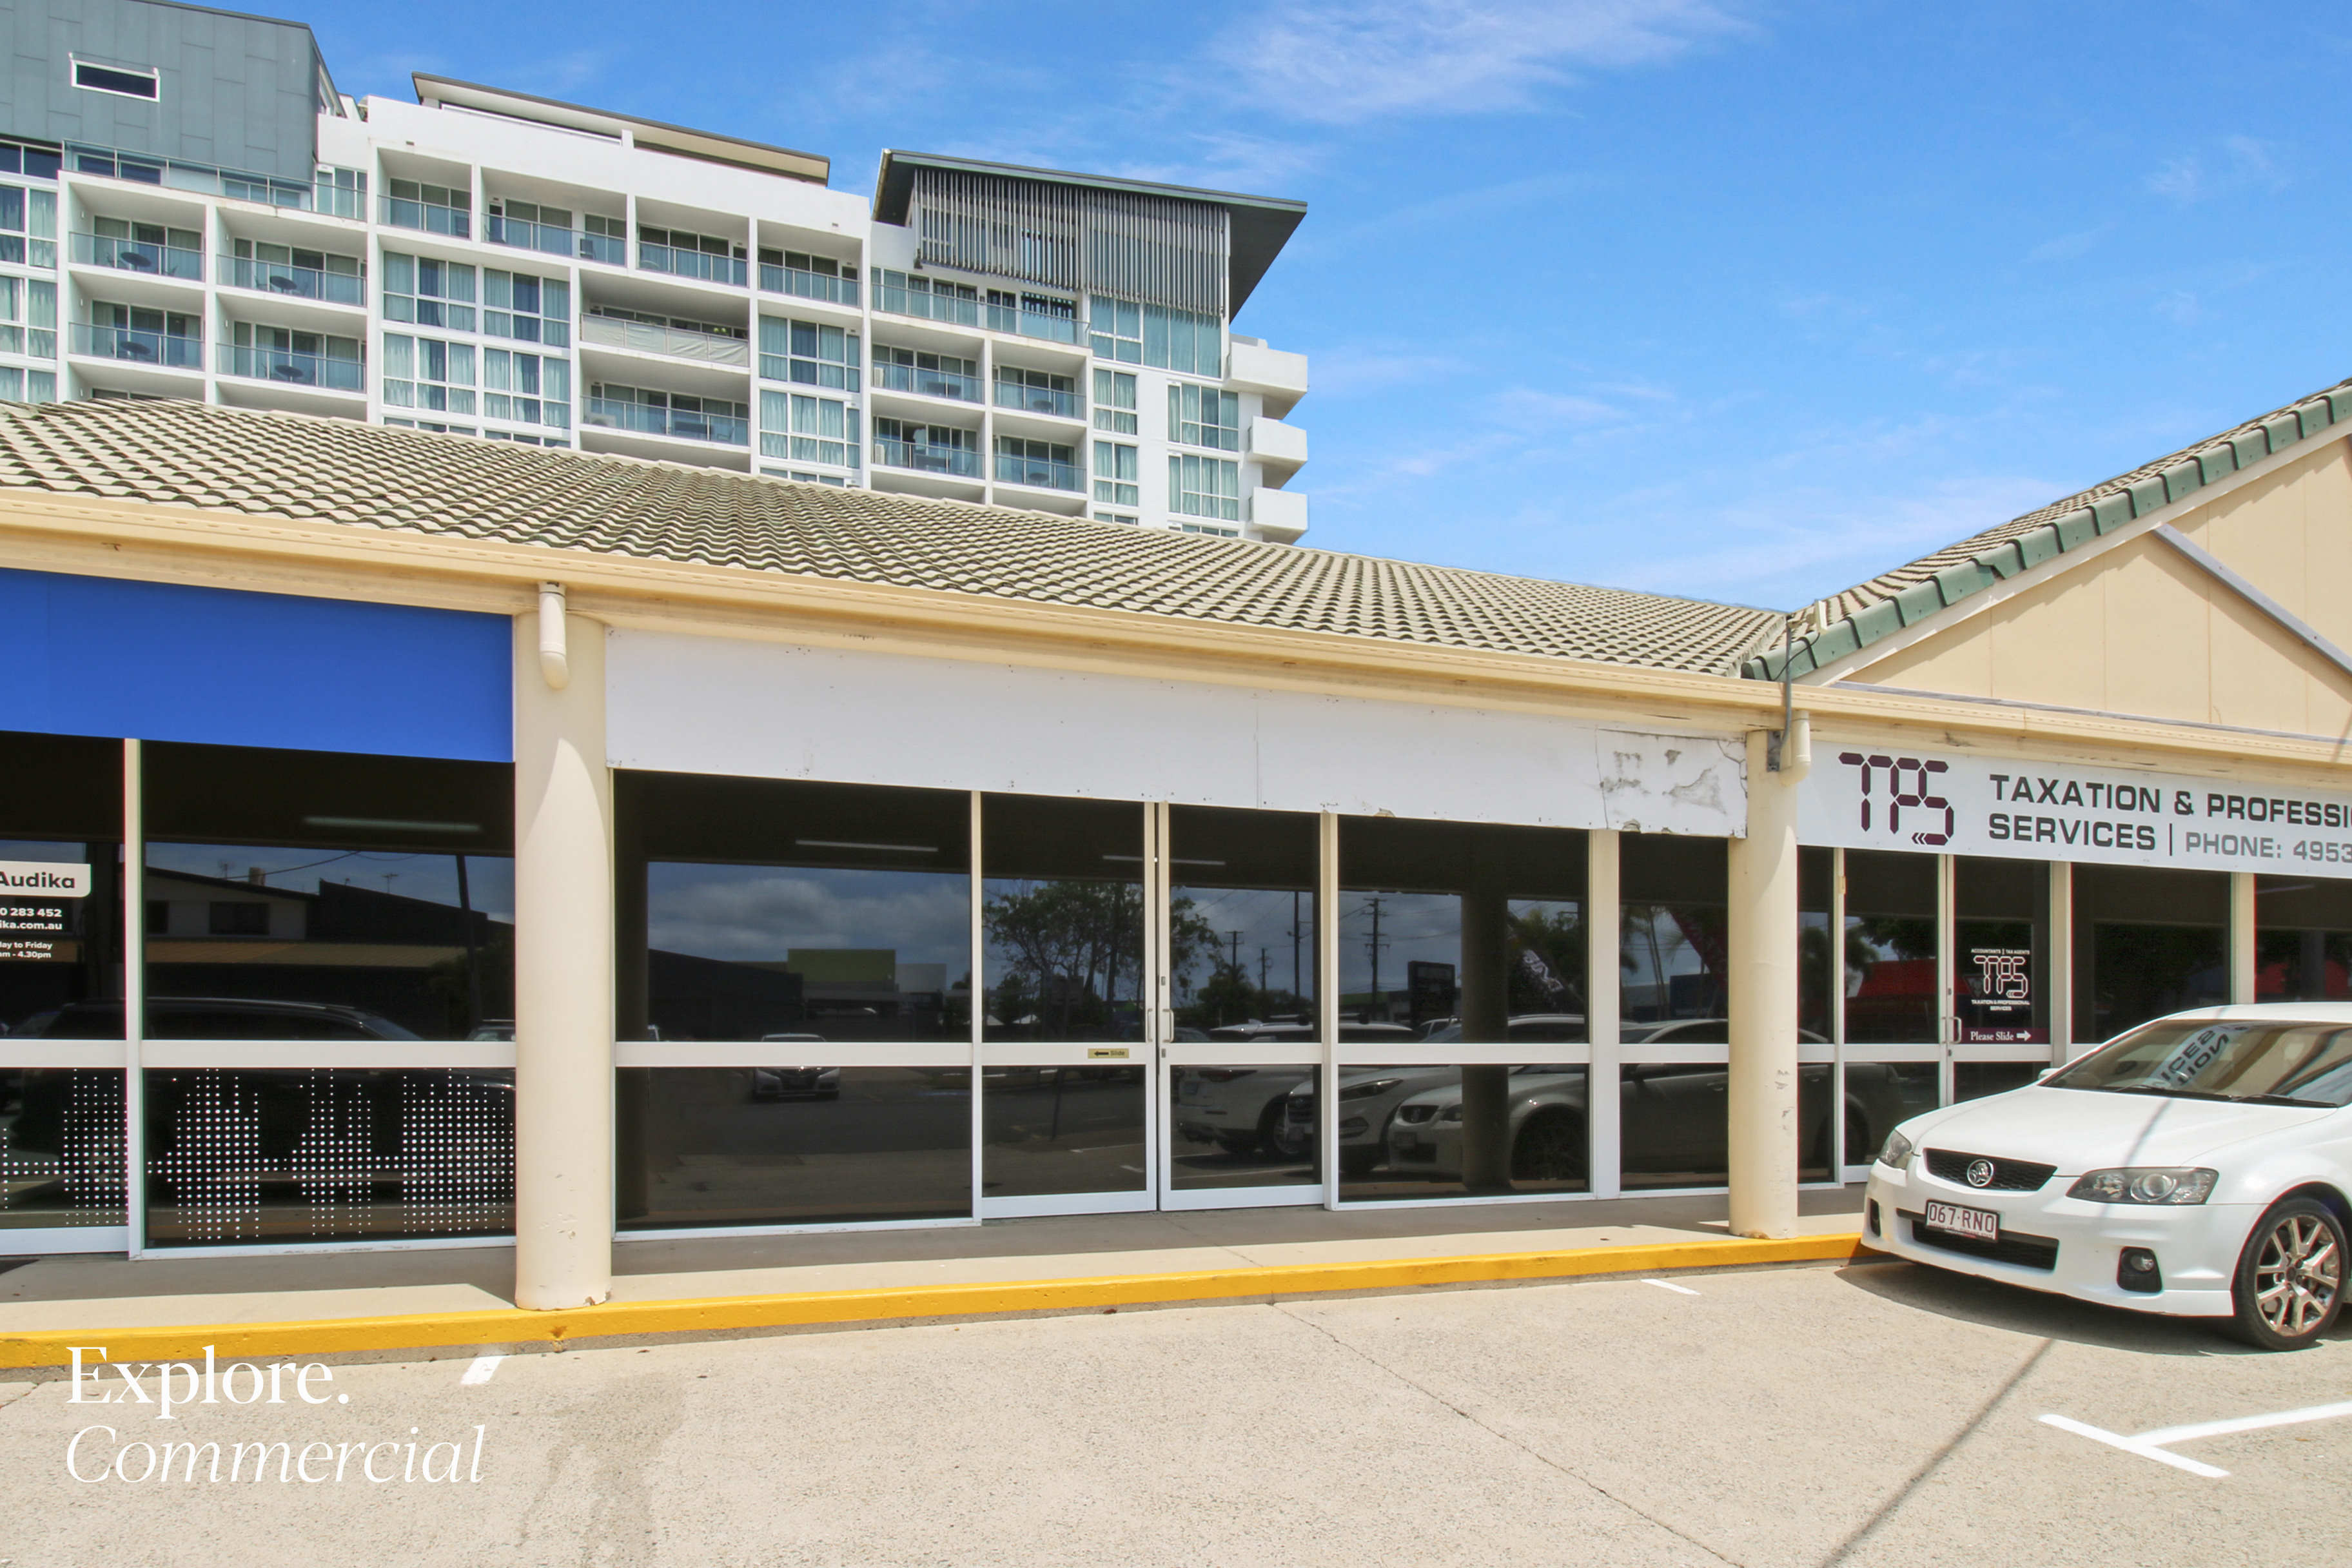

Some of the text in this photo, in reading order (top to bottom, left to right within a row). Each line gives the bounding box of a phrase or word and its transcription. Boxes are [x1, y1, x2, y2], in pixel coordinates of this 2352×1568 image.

[1838, 752, 1954, 846] TPS
[1989, 774, 2352, 828] TAXATION & PROFESSI
[1988, 812, 2352, 863] SERVICES PHONE: 4953
[0, 871, 75, 888] Audika
[10, 908, 35, 917] 283
[37, 908, 63, 917] 452
[25, 941, 53, 950] Friday
[17, 951, 52, 959] 4.30pm
[1973, 956, 2028, 999] TPS
[1970, 1031, 2014, 1041] Please Slide
